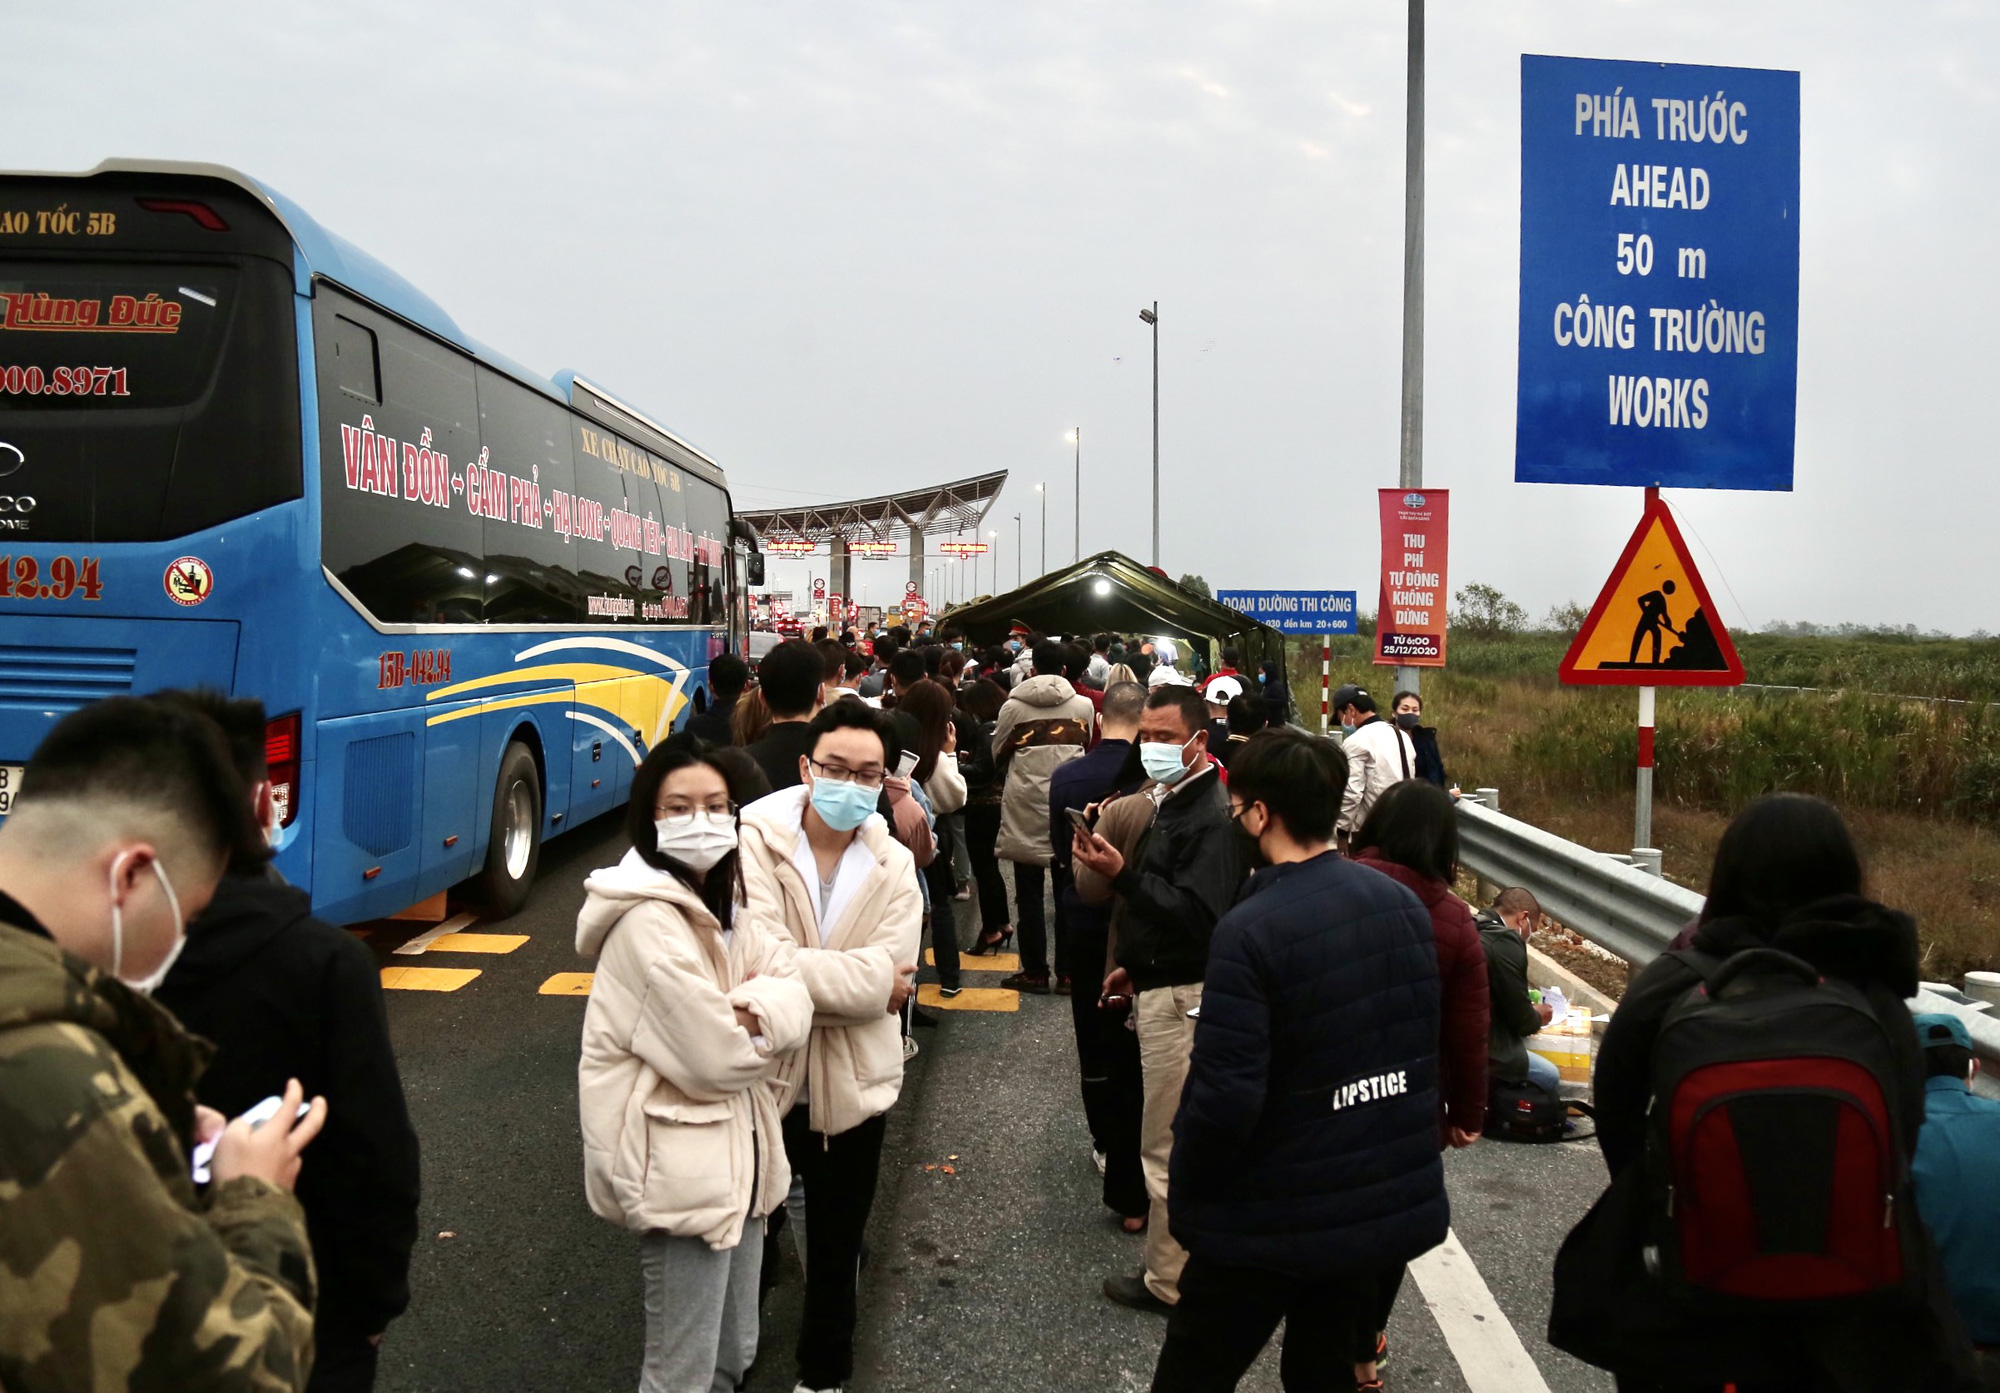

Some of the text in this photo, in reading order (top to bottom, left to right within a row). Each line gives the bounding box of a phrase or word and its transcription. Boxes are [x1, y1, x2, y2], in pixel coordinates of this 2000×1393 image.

[1575, 86, 1748, 145] PHÍA TRƯỚC
[1610, 163, 1710, 210] AHEAD
[36, 203, 81, 235] TỐC
[86, 212, 116, 235] 5B
[1616, 233, 1706, 279] 50 m
[2, 292, 182, 328] Hùng Đức
[1554, 294, 1766, 355] CÔNG TRƯỜNG
[1608, 374, 1710, 430] WORKS
[581, 427, 599, 458] XE
[631, 452, 651, 480] CAO
[341, 413, 398, 498] VÂN
[402, 426, 450, 509] ĐỒN
[466, 445, 508, 522] CẨM
[510, 464, 543, 530] PHẢ
[552, 488, 572, 544] HẠ
[571, 494, 604, 543] LONG
[610, 496, 643, 551] QUẢNG
[1403, 533, 1426, 549] THU
[1404, 550, 1424, 568] PHÍ
[1389, 569, 1439, 590] TỰ ĐỘNG
[1258, 594, 1298, 612] ĐƯỜNG
[1300, 598, 1318, 612] THI
[1320, 594, 1352, 612] CÔNG
[1392, 589, 1434, 607] KHÔNG
[1283, 618, 1298, 629] đến
[1299, 619, 1313, 628] km
[1316, 619, 1348, 629] 20+600
[1395, 607, 1429, 626] DỪNG
[1383, 645, 1438, 656] 25/12/2020
[1393, 634, 1430, 646] TỪ 6:00
[377, 649, 451, 689] 15B-042.94
[1333, 1070, 1408, 1111] LIPSTICE
